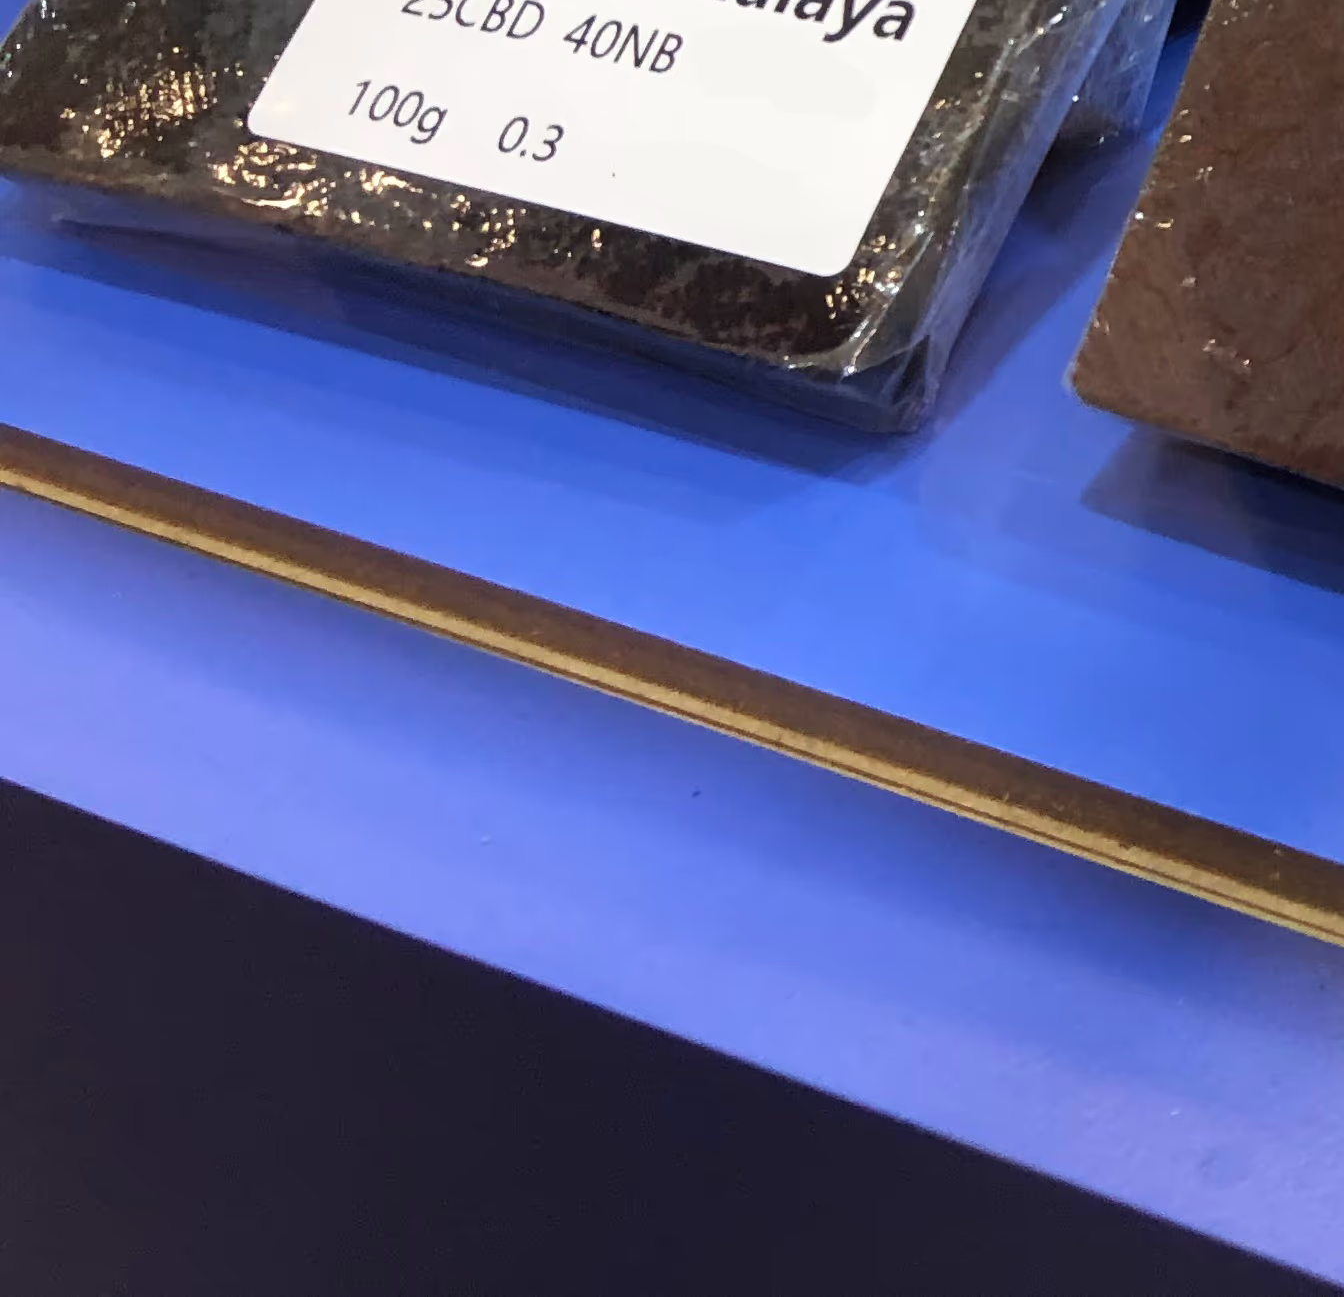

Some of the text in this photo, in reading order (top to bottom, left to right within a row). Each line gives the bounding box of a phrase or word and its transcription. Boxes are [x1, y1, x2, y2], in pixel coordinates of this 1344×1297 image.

[562, 12, 685, 74] 40NB
[346, 79, 565, 163] 100g 0.3
